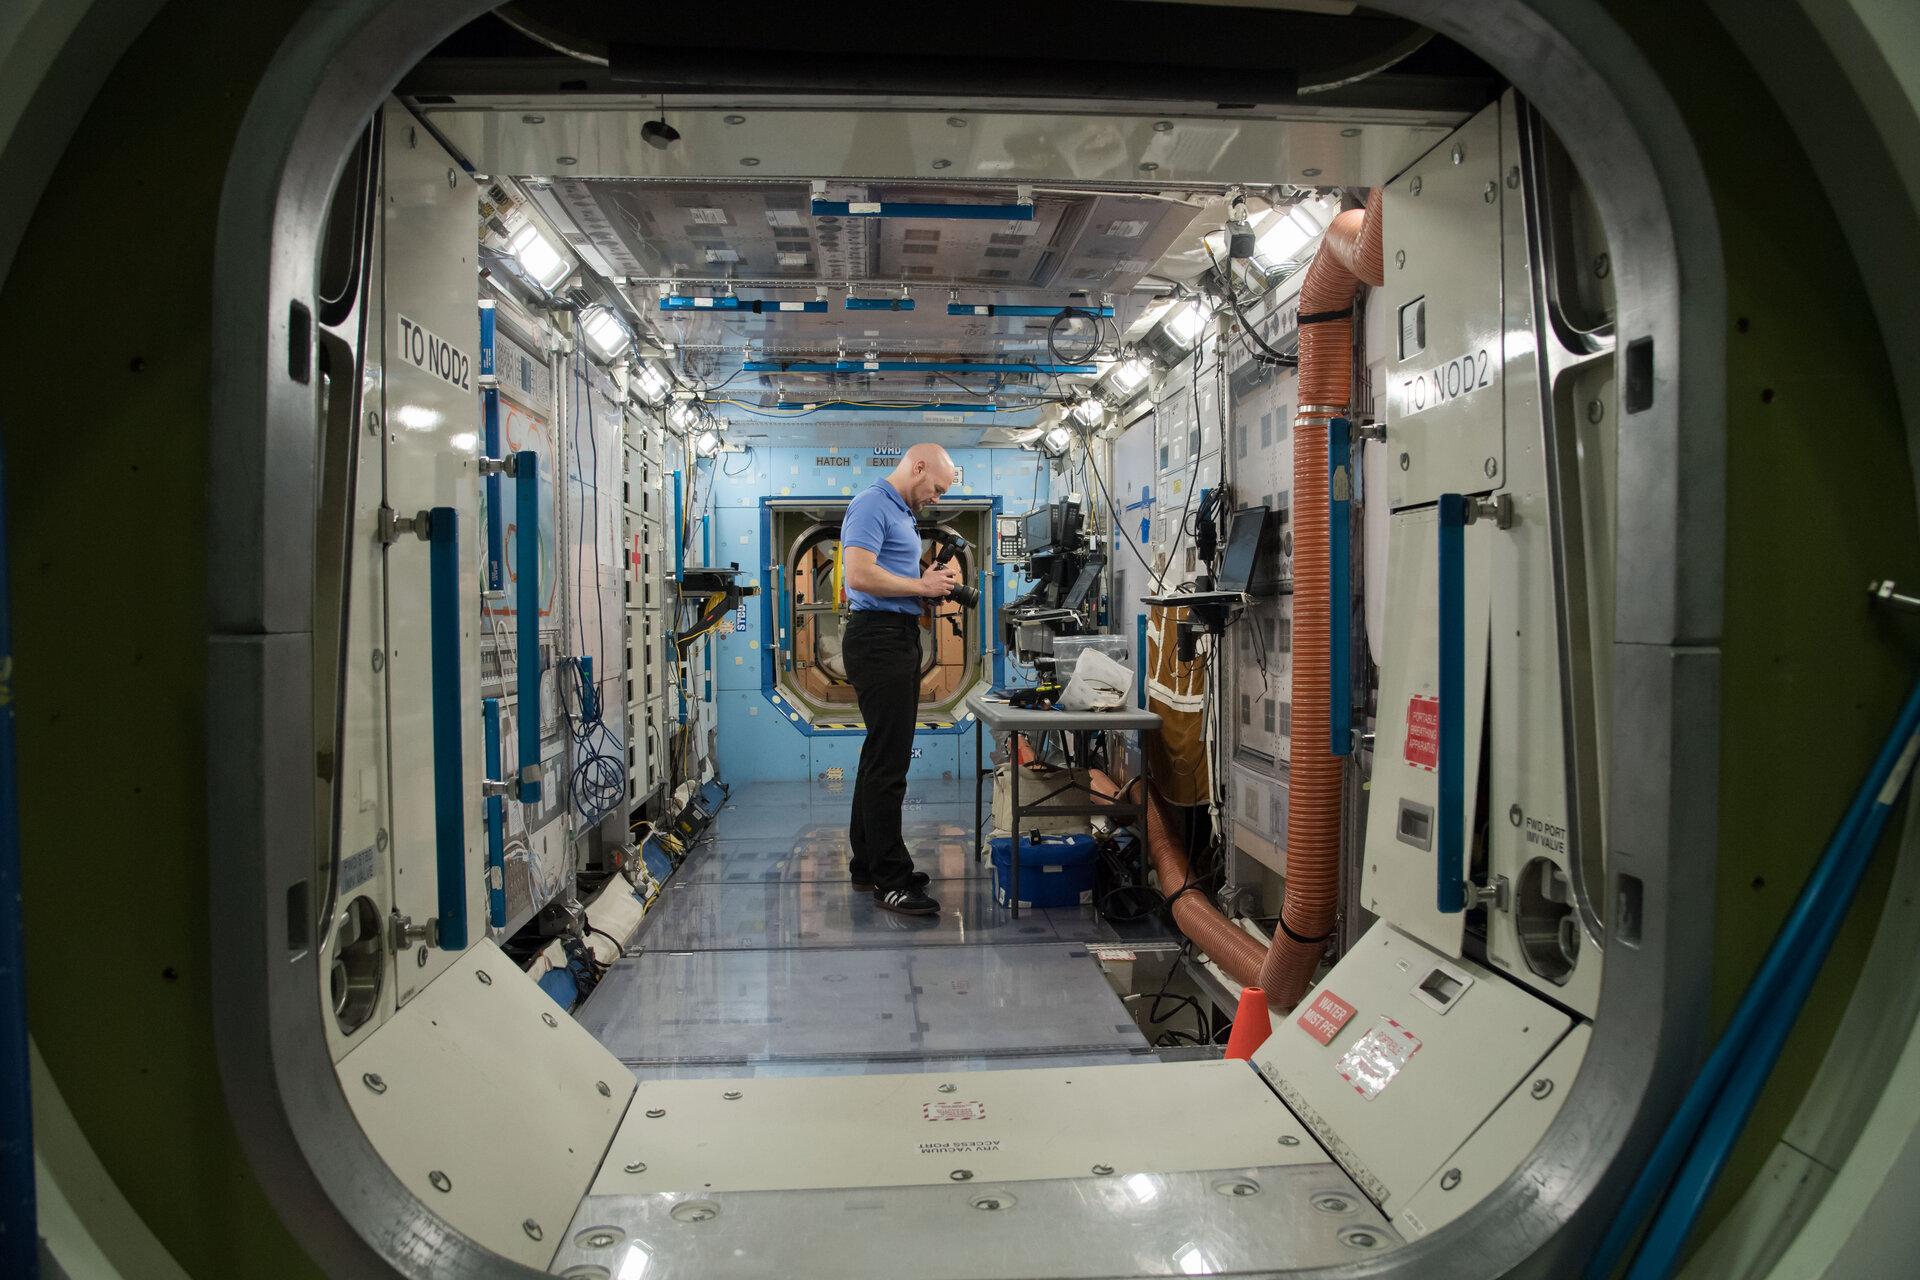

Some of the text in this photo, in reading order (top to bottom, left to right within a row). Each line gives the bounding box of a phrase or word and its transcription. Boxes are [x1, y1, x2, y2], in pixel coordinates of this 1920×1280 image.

[400, 317, 469, 390] TO NOD2
[1404, 349, 1488, 414] TO NOD2
[874, 446, 901, 455] OVHD
[816, 457, 850, 466] HATCH
[872, 457, 895, 466] EXIT
[1412, 711, 1437, 726] PORTABLE
[1410, 724, 1437, 740] BREATHING
[1409, 738, 1436, 754] APPARATUS
[1526, 817, 1566, 841] FWD PORT
[1526, 831, 1564, 854] IMV VALVE
[1318, 996, 1347, 1021] WATER
[1303, 1008, 1338, 1038] MIST PFE
